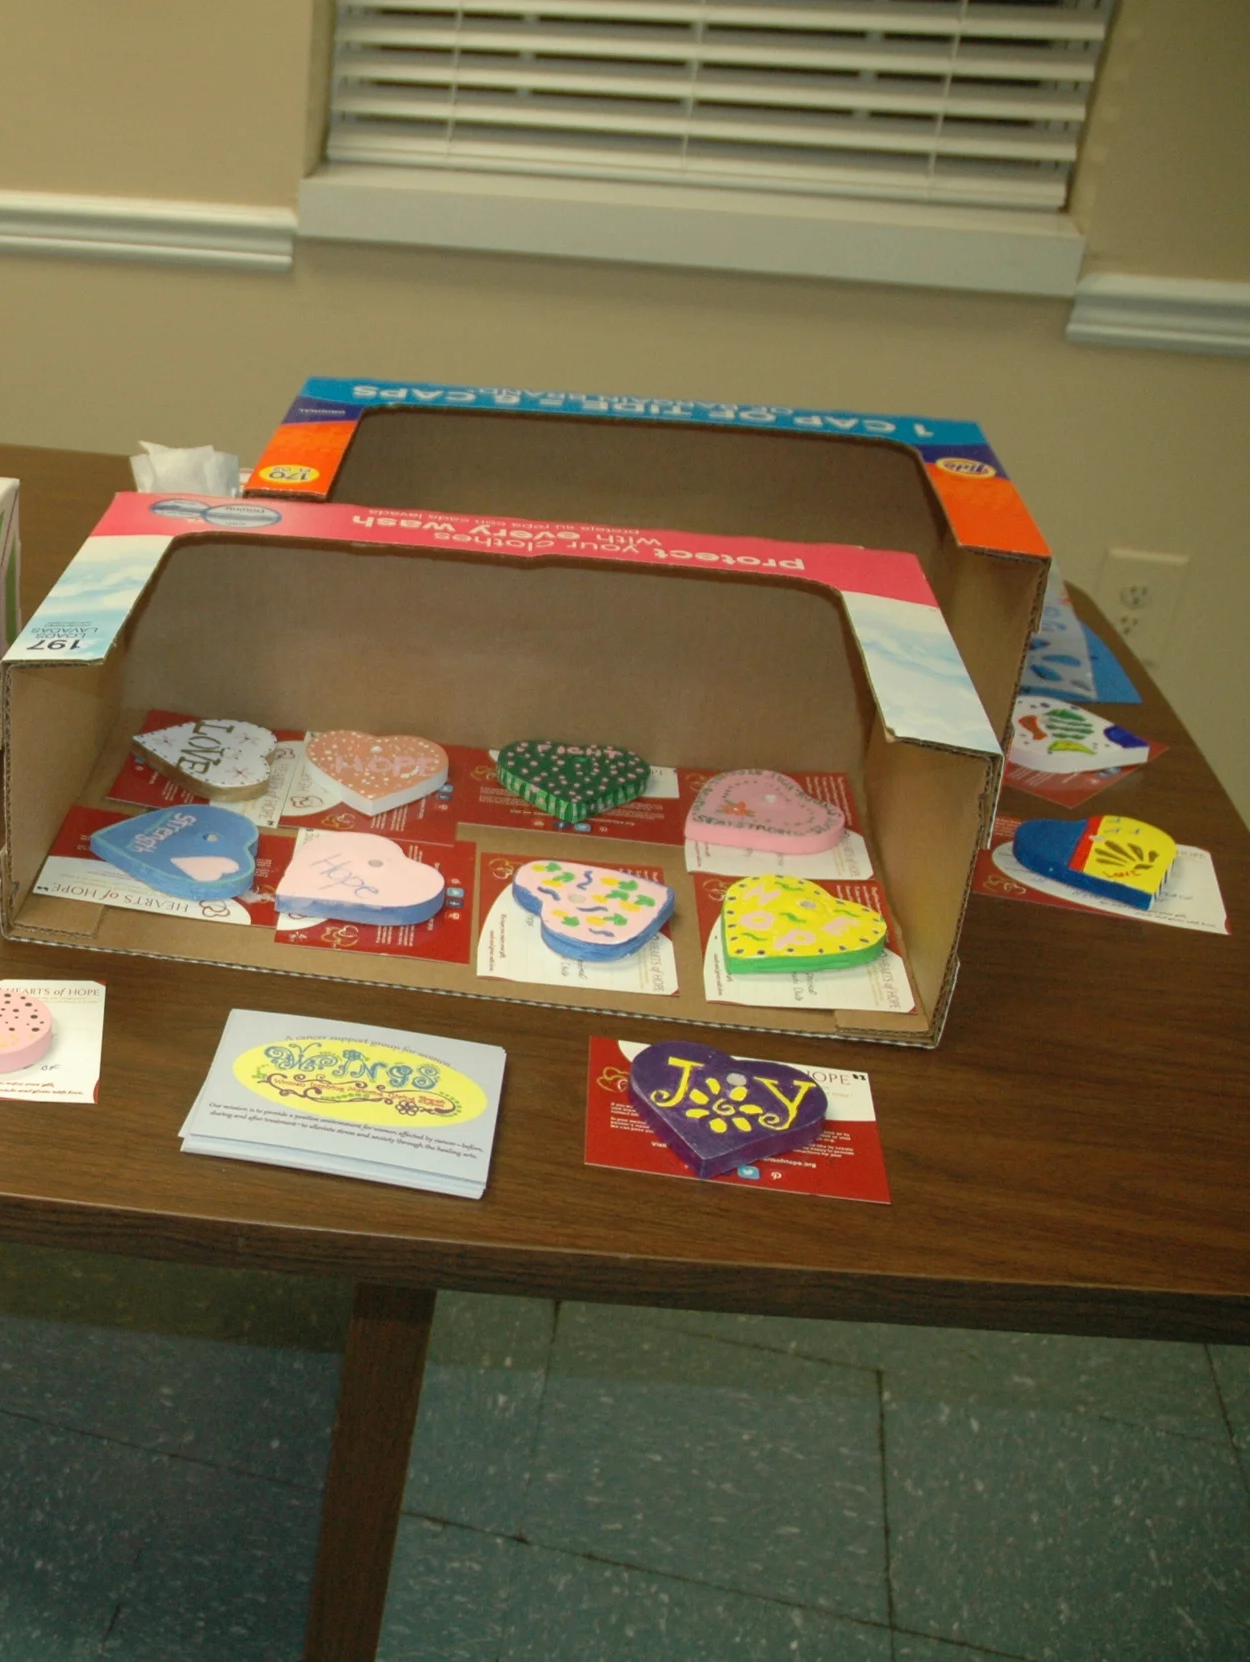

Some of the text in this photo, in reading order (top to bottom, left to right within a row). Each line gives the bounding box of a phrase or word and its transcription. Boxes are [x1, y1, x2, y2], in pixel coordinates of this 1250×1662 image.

[352, 385, 477, 402] CAPS
[708, 408, 777, 422] OF
[793, 415, 896, 433] CAP
[267, 471, 309, 481] 170
[368, 508, 423, 520] lavada
[352, 515, 662, 546] with every wash
[434, 531, 639, 553] your clothes
[653, 547, 806, 570] protect
[26, 639, 82, 651] 197
[175, 721, 235, 775] LOVE
[310, 852, 380, 899] Hope
[51, 881, 99, 898] HOPE
[100, 888, 120, 901] of
[125, 893, 191, 914] HEARTS
[53, 987, 67, 997] of
[69, 988, 101, 997] HOPE
[329, 1035, 369, 1044] support
[369, 1040, 401, 1051] group
[402, 1046, 417, 1055] for
[418, 1051, 452, 1068] women
[223, 1104, 248, 1112] mission
[263, 1109, 288, 1118] provide
[294, 1113, 320, 1122] positive
[320, 1117, 362, 1129] environment
[361, 1123, 372, 1131] for
[373, 1127, 397, 1135] women
[398, 1130, 424, 1140] affected
[209, 1110, 233, 1120] during
[248, 1115, 264, 1123] after
[309, 1123, 336, 1133] alleviate
[336, 1128, 356, 1137] stress
[356, 1130, 370, 1138] and
[371, 1134, 395, 1144] anxiety
[424, 1142, 436, 1150] the
[436, 1146, 462, 1157] healing
